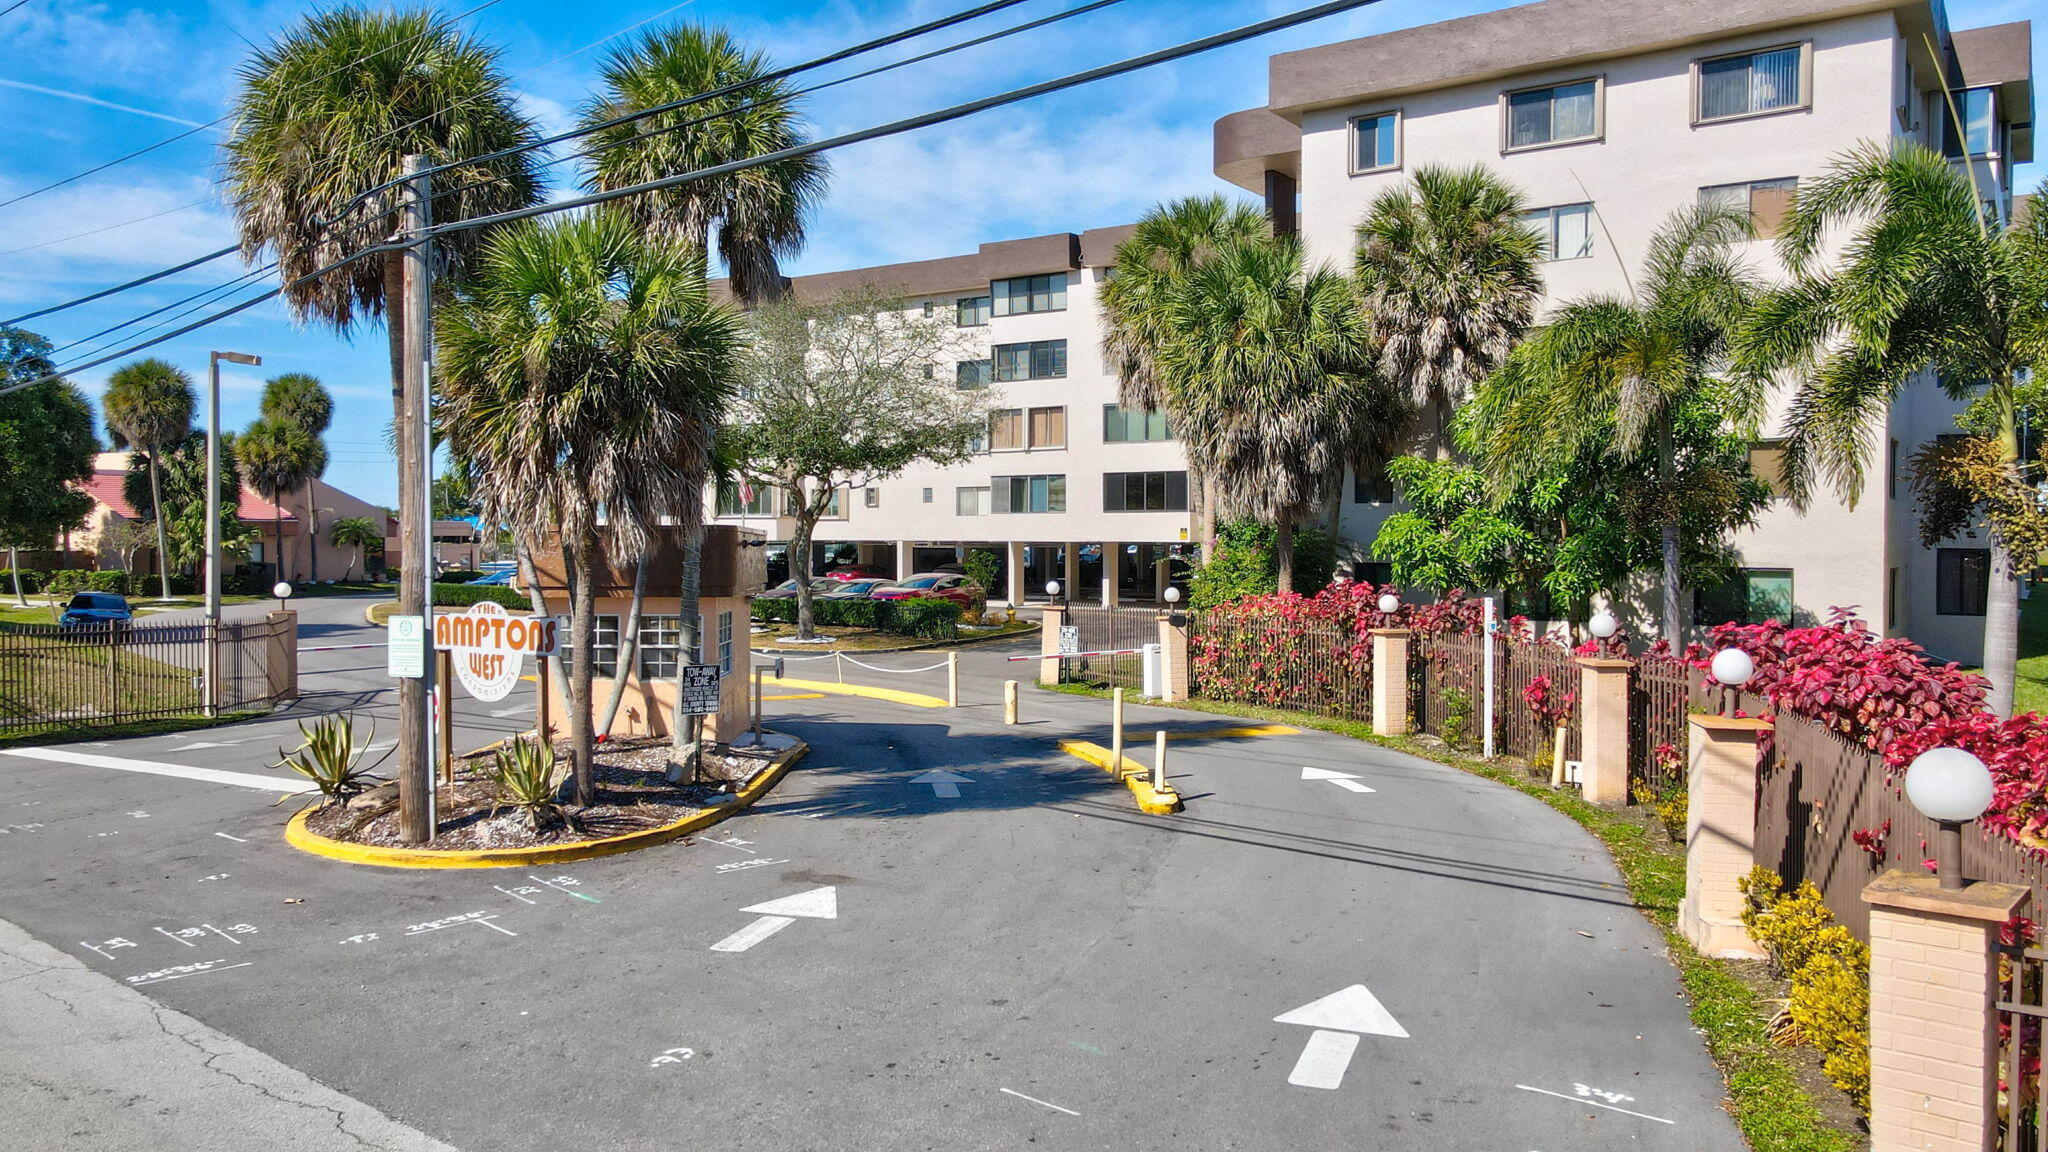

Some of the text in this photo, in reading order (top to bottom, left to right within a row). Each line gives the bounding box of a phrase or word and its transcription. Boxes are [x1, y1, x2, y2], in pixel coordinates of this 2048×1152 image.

[476, 604, 496, 615] THE
[437, 616, 556, 653] AMPTONS
[469, 652, 505, 681] WEST
[686, 667, 717, 677] TOW-AWAY
[693, 676, 710, 686] ZONE
